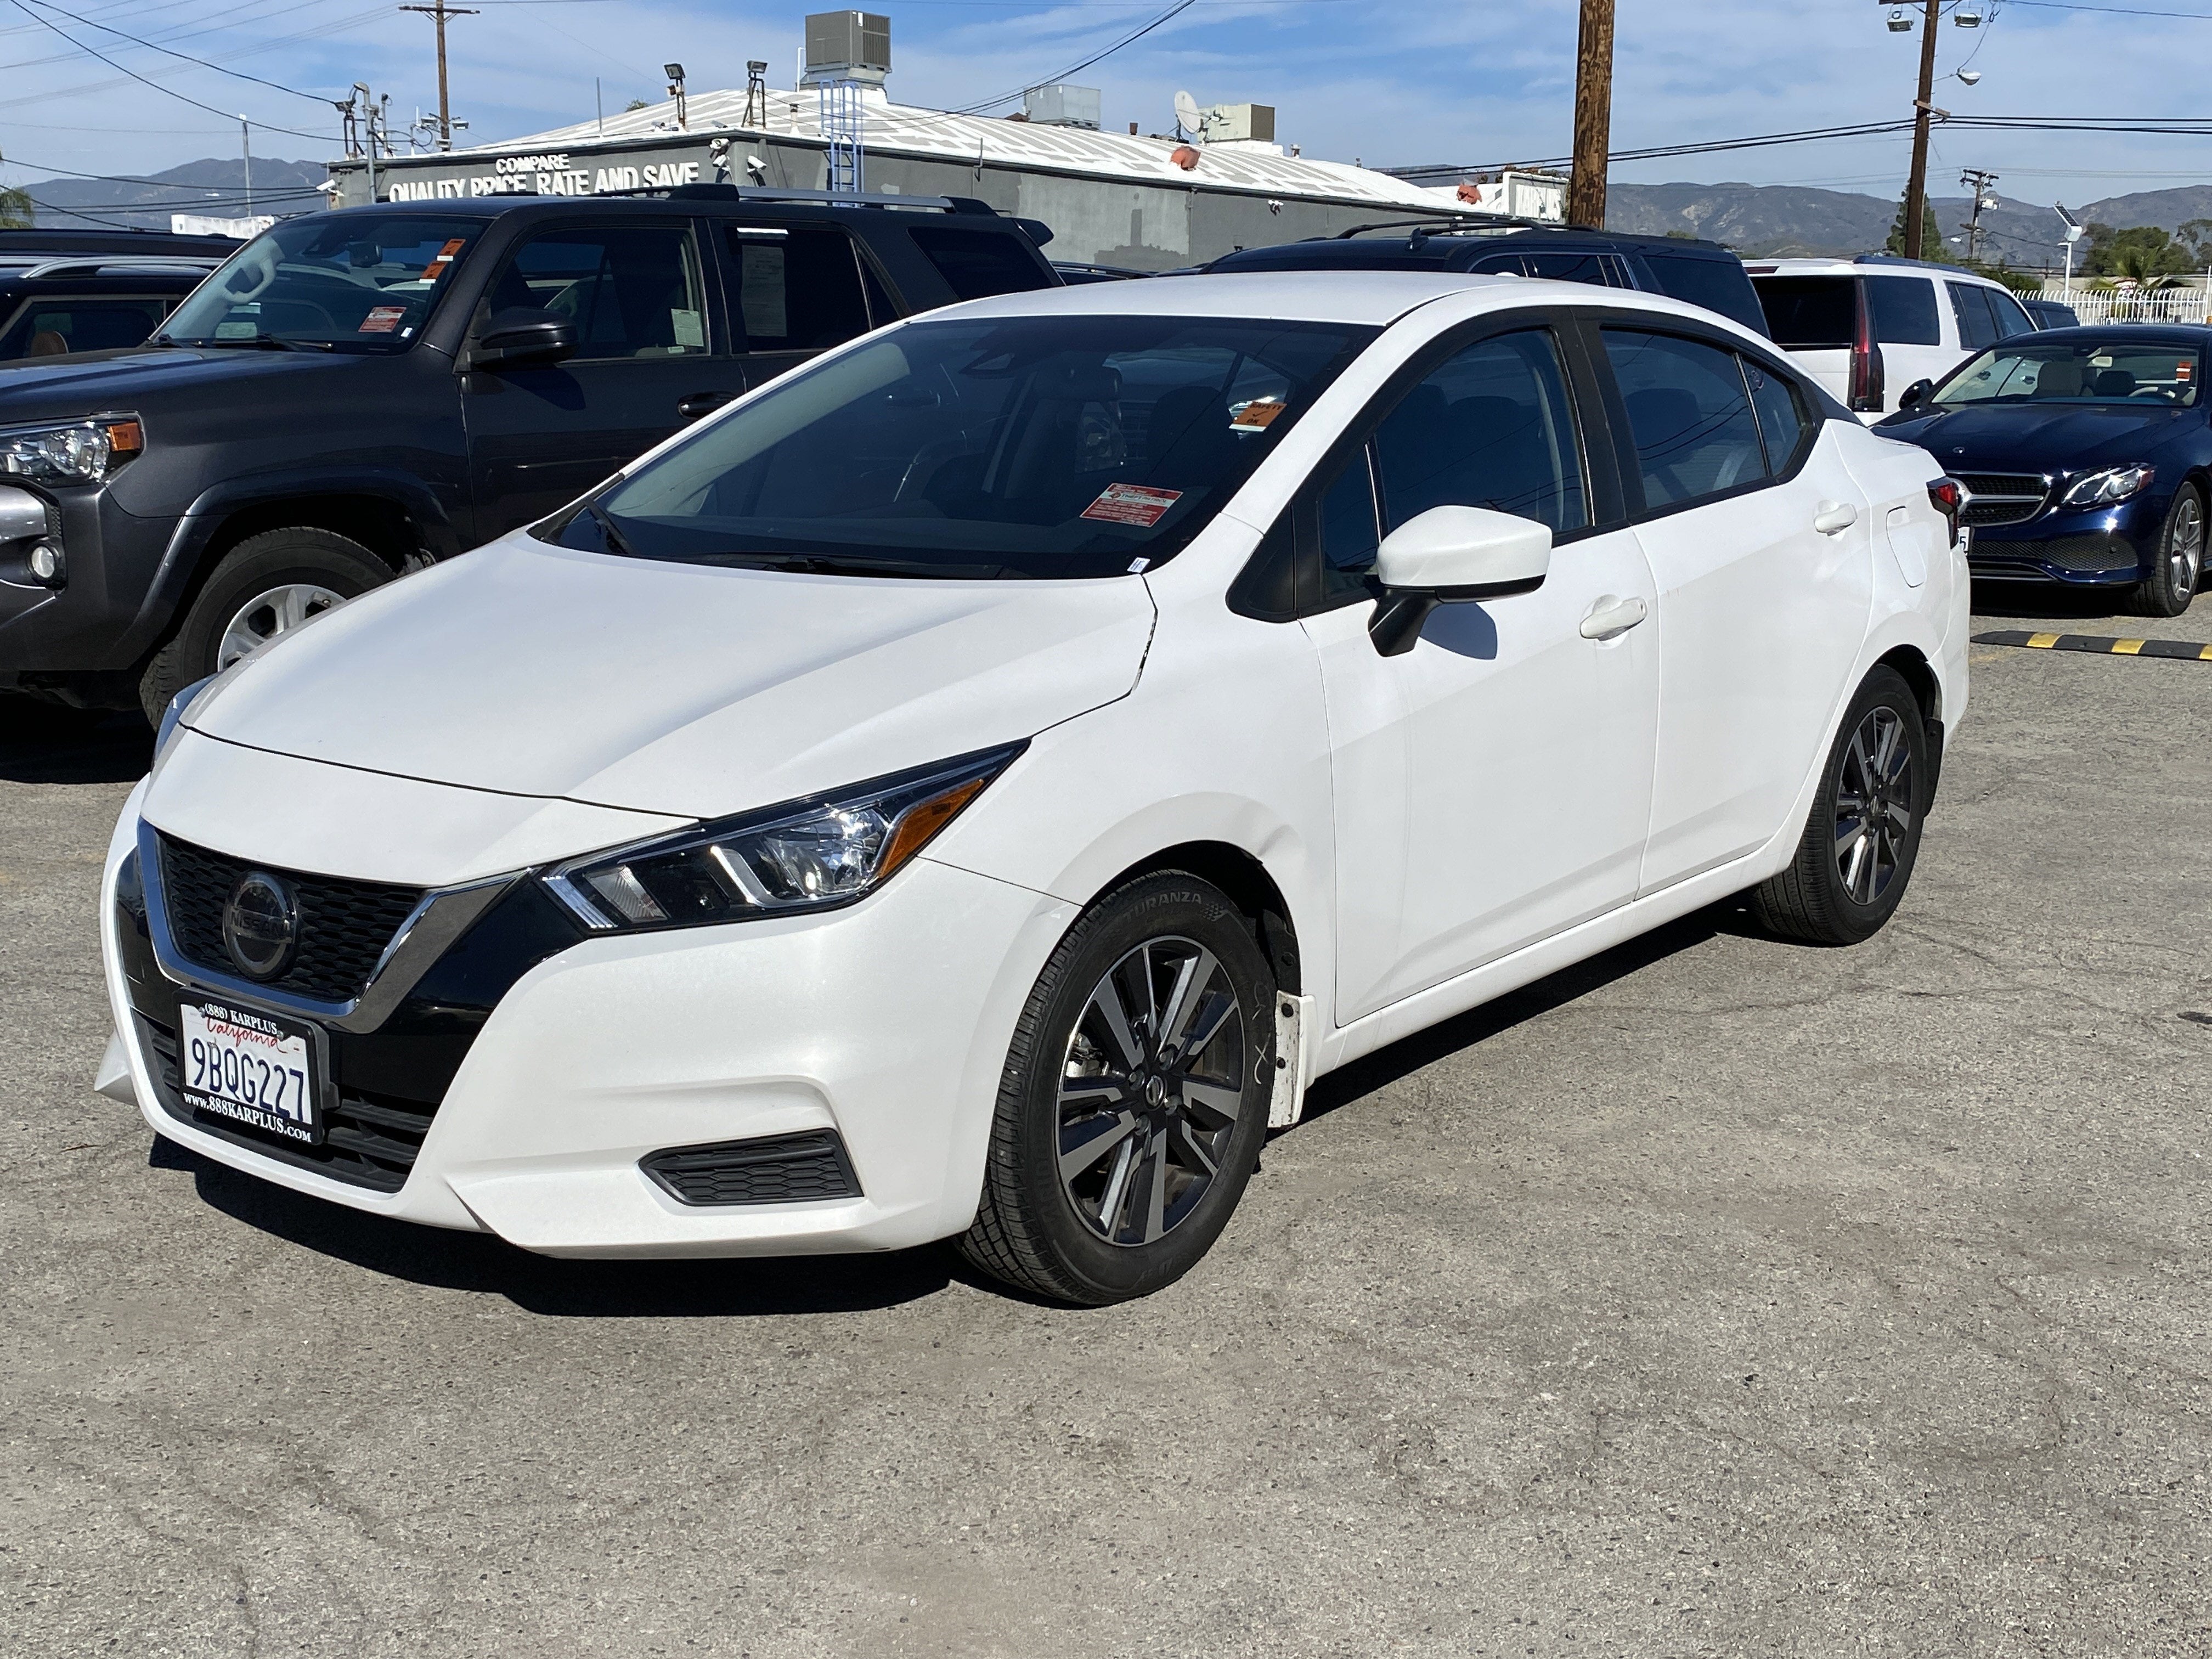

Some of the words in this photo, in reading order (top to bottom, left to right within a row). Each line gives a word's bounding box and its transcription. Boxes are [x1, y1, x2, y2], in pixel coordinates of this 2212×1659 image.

[495, 154, 571, 174] COMPARE
[389, 178, 466, 202] QUALITY
[470, 174, 527, 198] PRICE
[536, 170, 590, 196] RATE
[594, 166, 639, 193] AND
[643, 162, 699, 187] SAVE
[1249, 400, 1283, 410] SAFETY
[1123, 891, 1202, 923] TURANZA
[205, 1003, 228, 1020] (888)
[230, 1010, 278, 1035] KARPLUS
[207, 1017, 287, 1053] California
[192, 1038, 304, 1121] 9BQG227
[183, 1093, 312, 1142] www.888KARPLUS.COM
